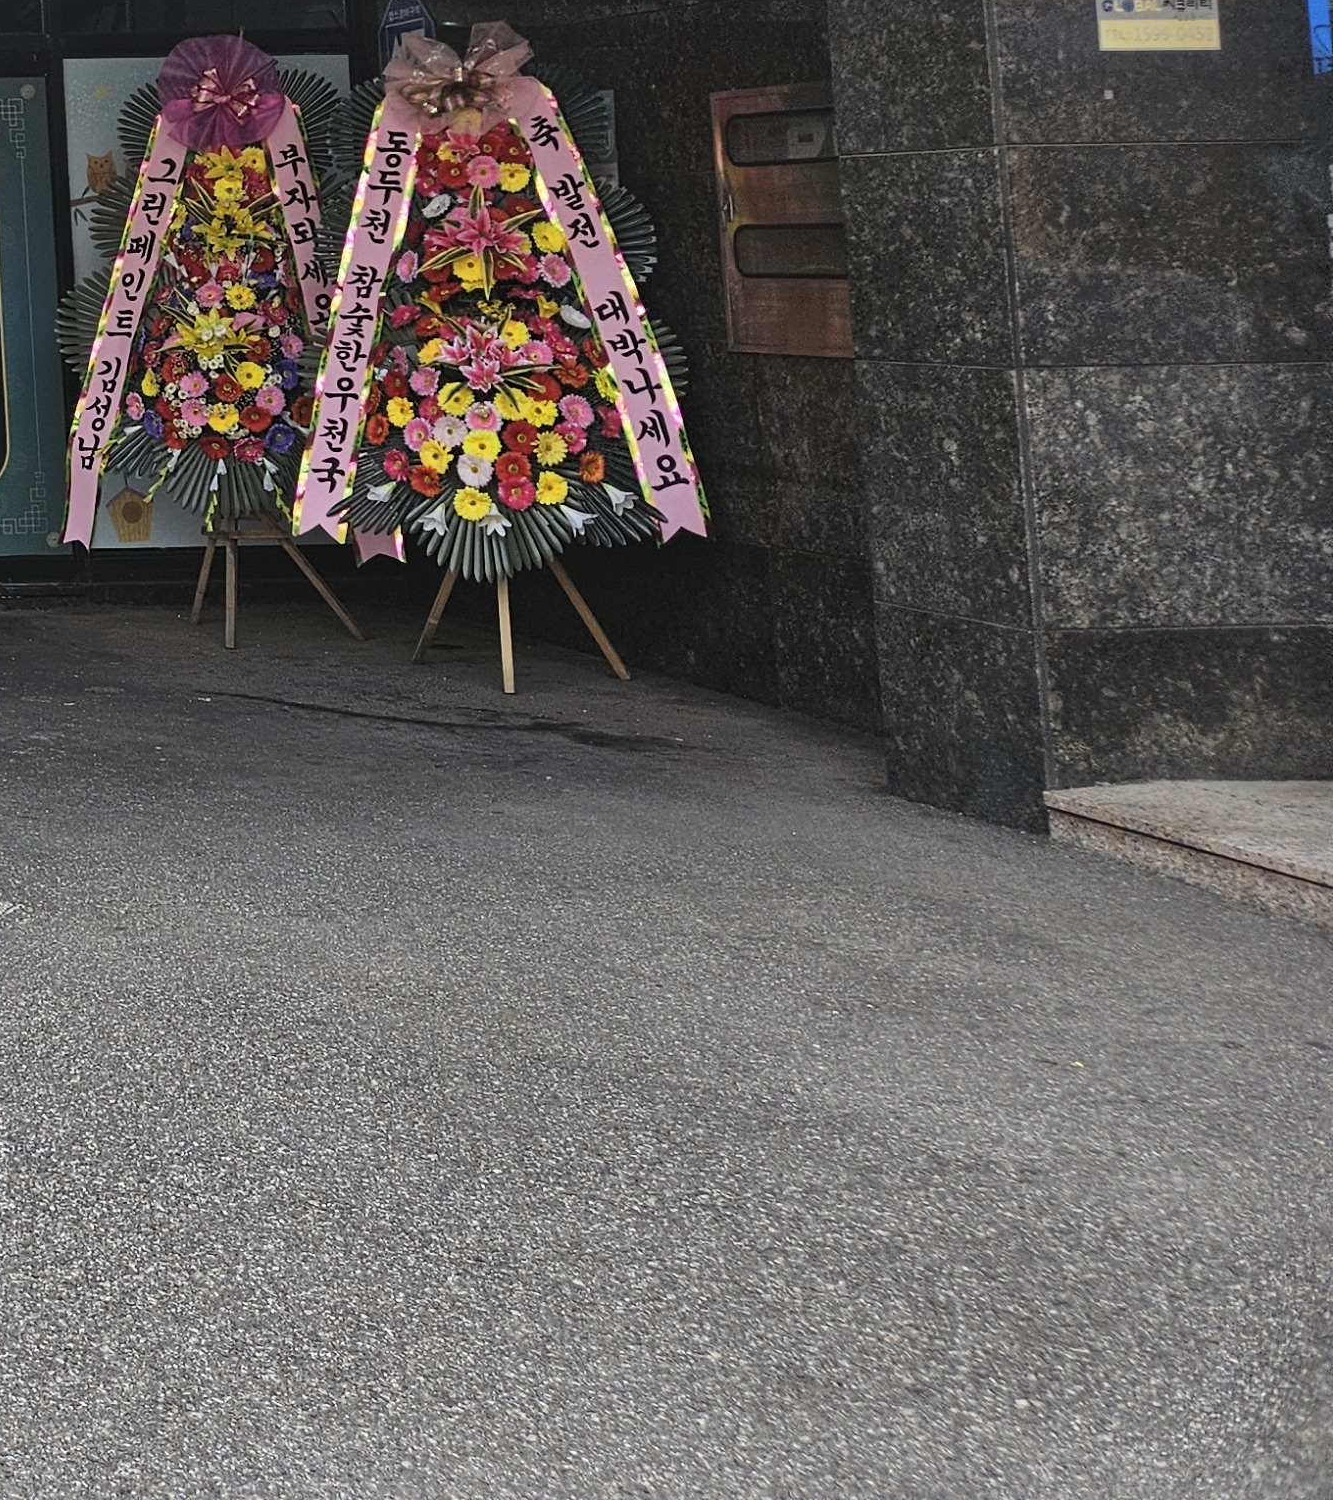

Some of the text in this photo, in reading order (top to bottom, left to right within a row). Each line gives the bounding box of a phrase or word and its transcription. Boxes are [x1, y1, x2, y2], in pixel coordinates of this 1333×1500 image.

[78, 156, 178, 471] 그린페인트 김성남
[311, 130, 412, 494] 동두천 참숯한우천국
[530, 115, 691, 492] 축 발전 대박나세요
